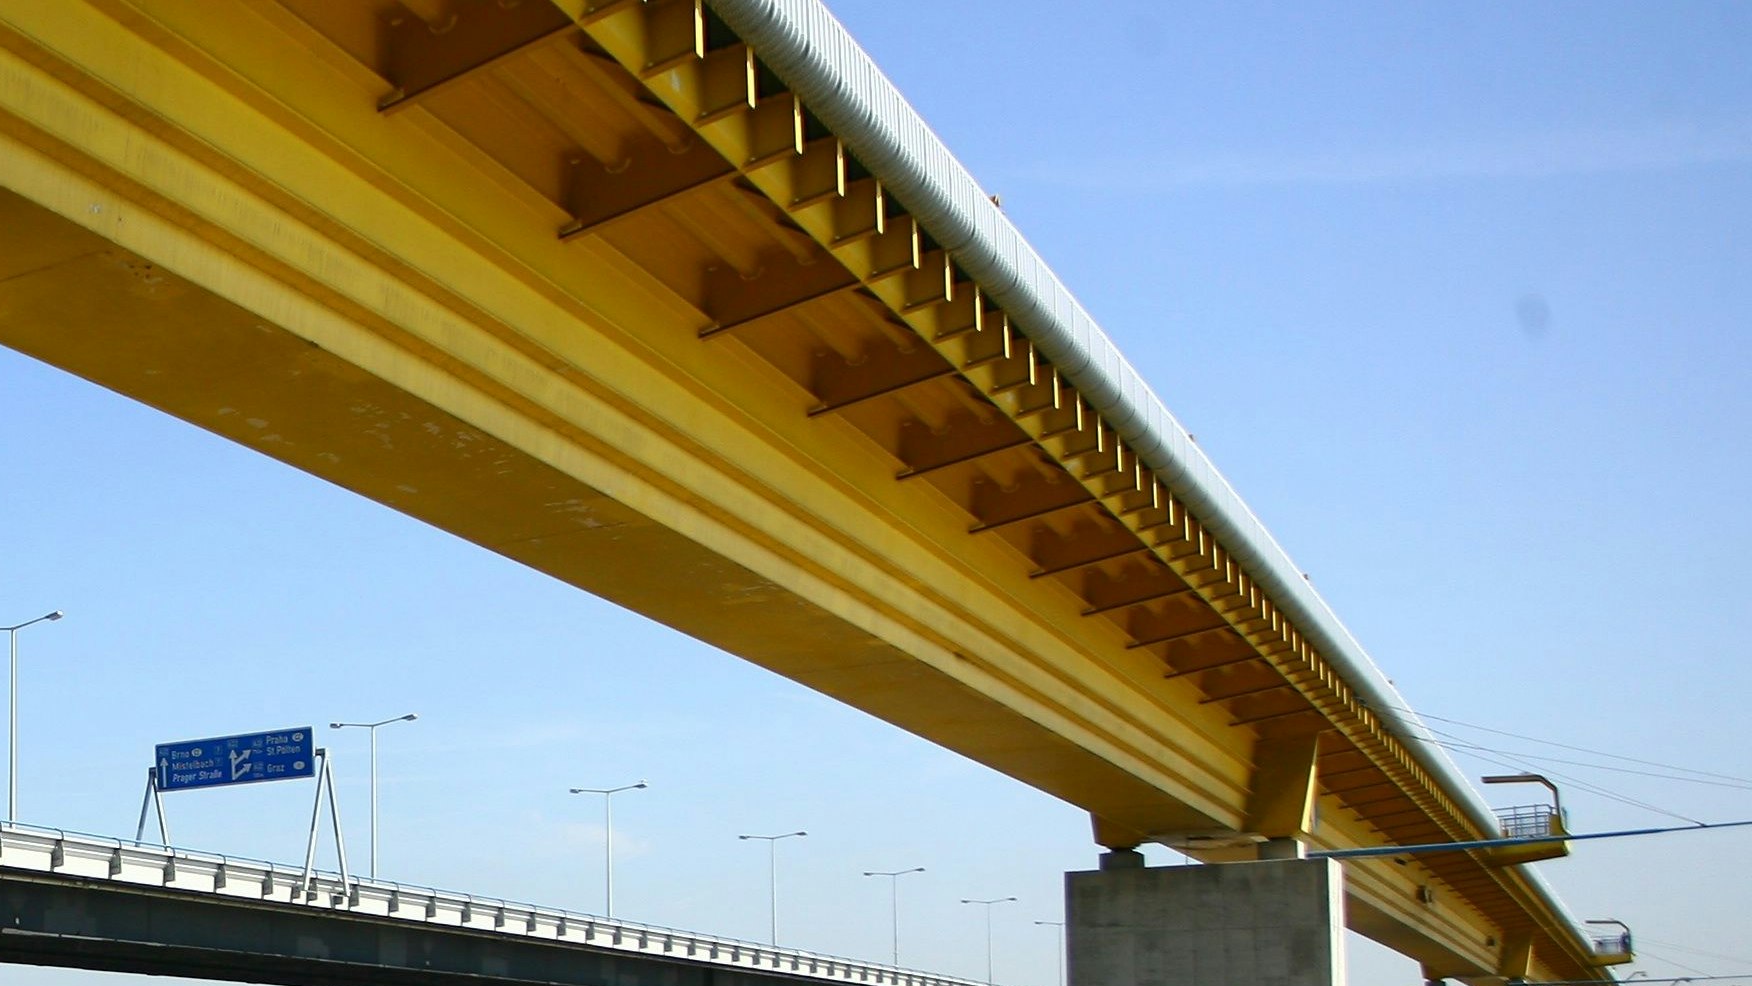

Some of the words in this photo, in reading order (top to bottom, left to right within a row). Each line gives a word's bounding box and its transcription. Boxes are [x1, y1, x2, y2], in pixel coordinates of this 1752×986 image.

[171, 751, 190, 760] Brno
[267, 763, 285, 773] Graz
[172, 773, 197, 784] Prager
